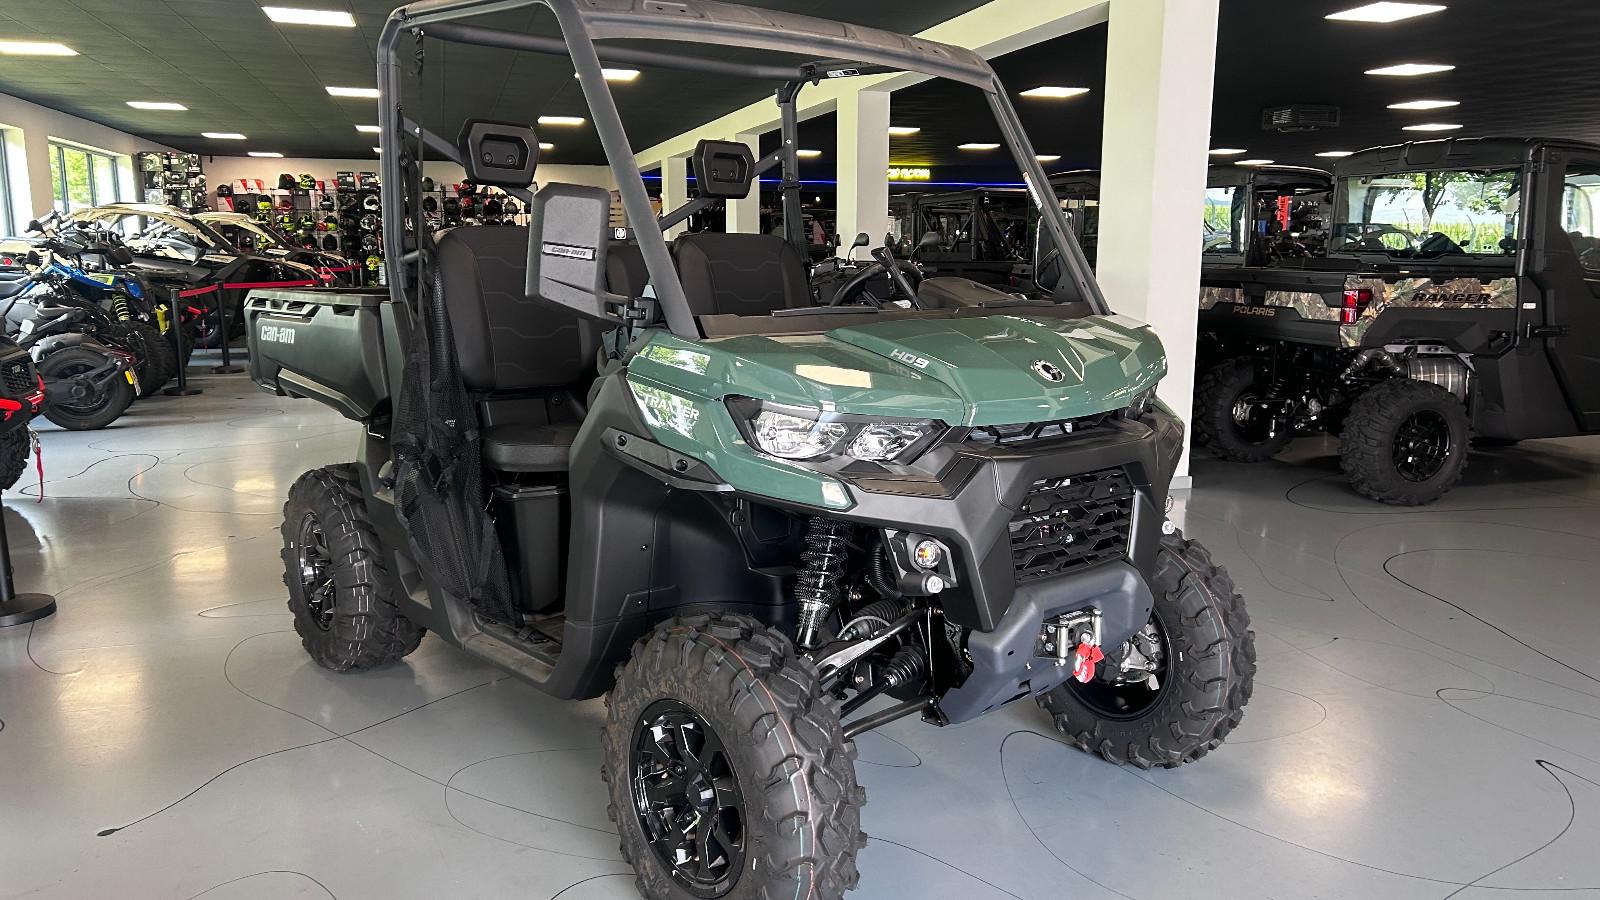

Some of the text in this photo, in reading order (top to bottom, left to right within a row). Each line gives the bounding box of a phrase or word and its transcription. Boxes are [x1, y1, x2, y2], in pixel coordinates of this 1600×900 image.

[1411, 293, 1491, 304] RANGER
[1233, 305, 1275, 316] POLARIS
[890, 348, 929, 369] HD9
[641, 391, 700, 421] TRAER
